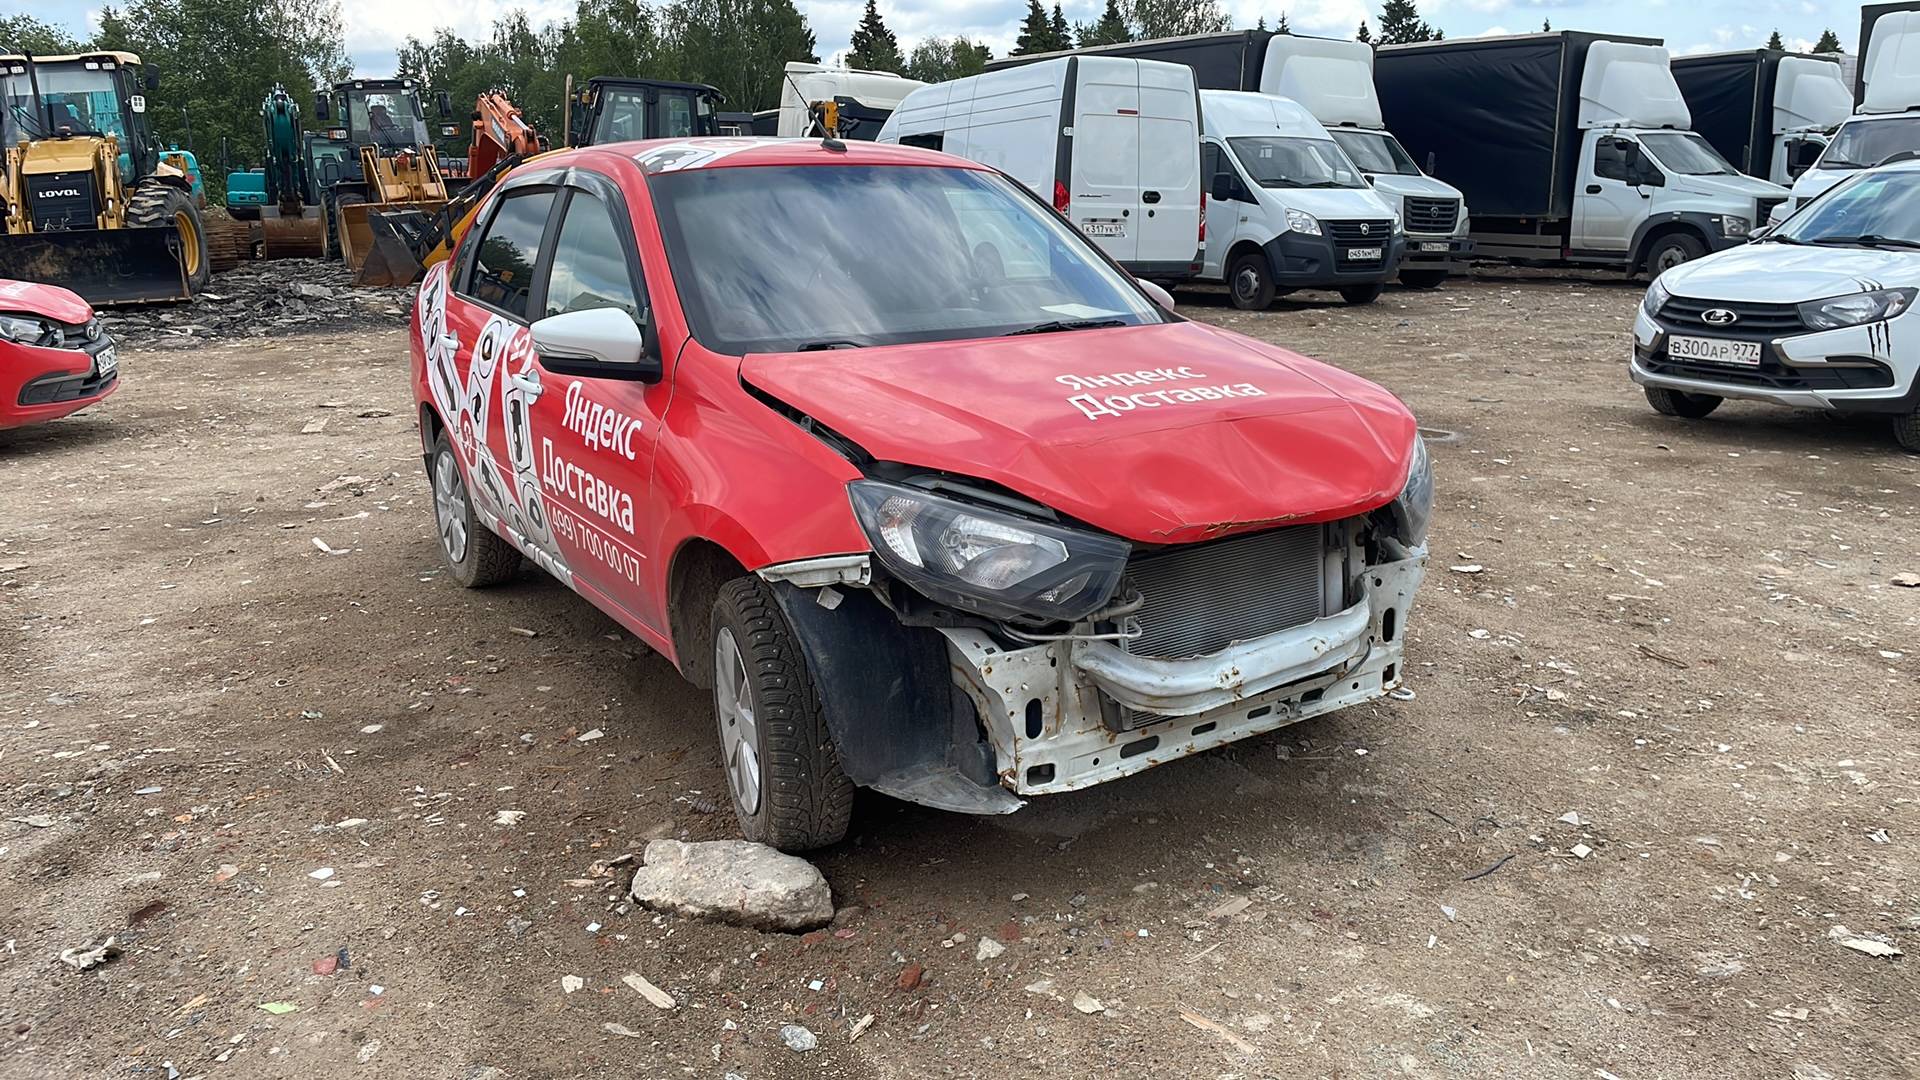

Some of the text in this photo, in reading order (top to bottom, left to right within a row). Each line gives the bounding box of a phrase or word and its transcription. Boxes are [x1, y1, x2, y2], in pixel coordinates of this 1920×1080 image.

[39, 189, 81, 198] LOVOL
[1673, 339, 1757, 358] В300АР 977
[1055, 366, 1207, 391] Яндекс
[562, 380, 643, 461] Яндекс
[1066, 383, 1268, 421] Доставка
[542, 436, 635, 535] Доставка
[546, 502, 640, 586] (499) 700 00 07
